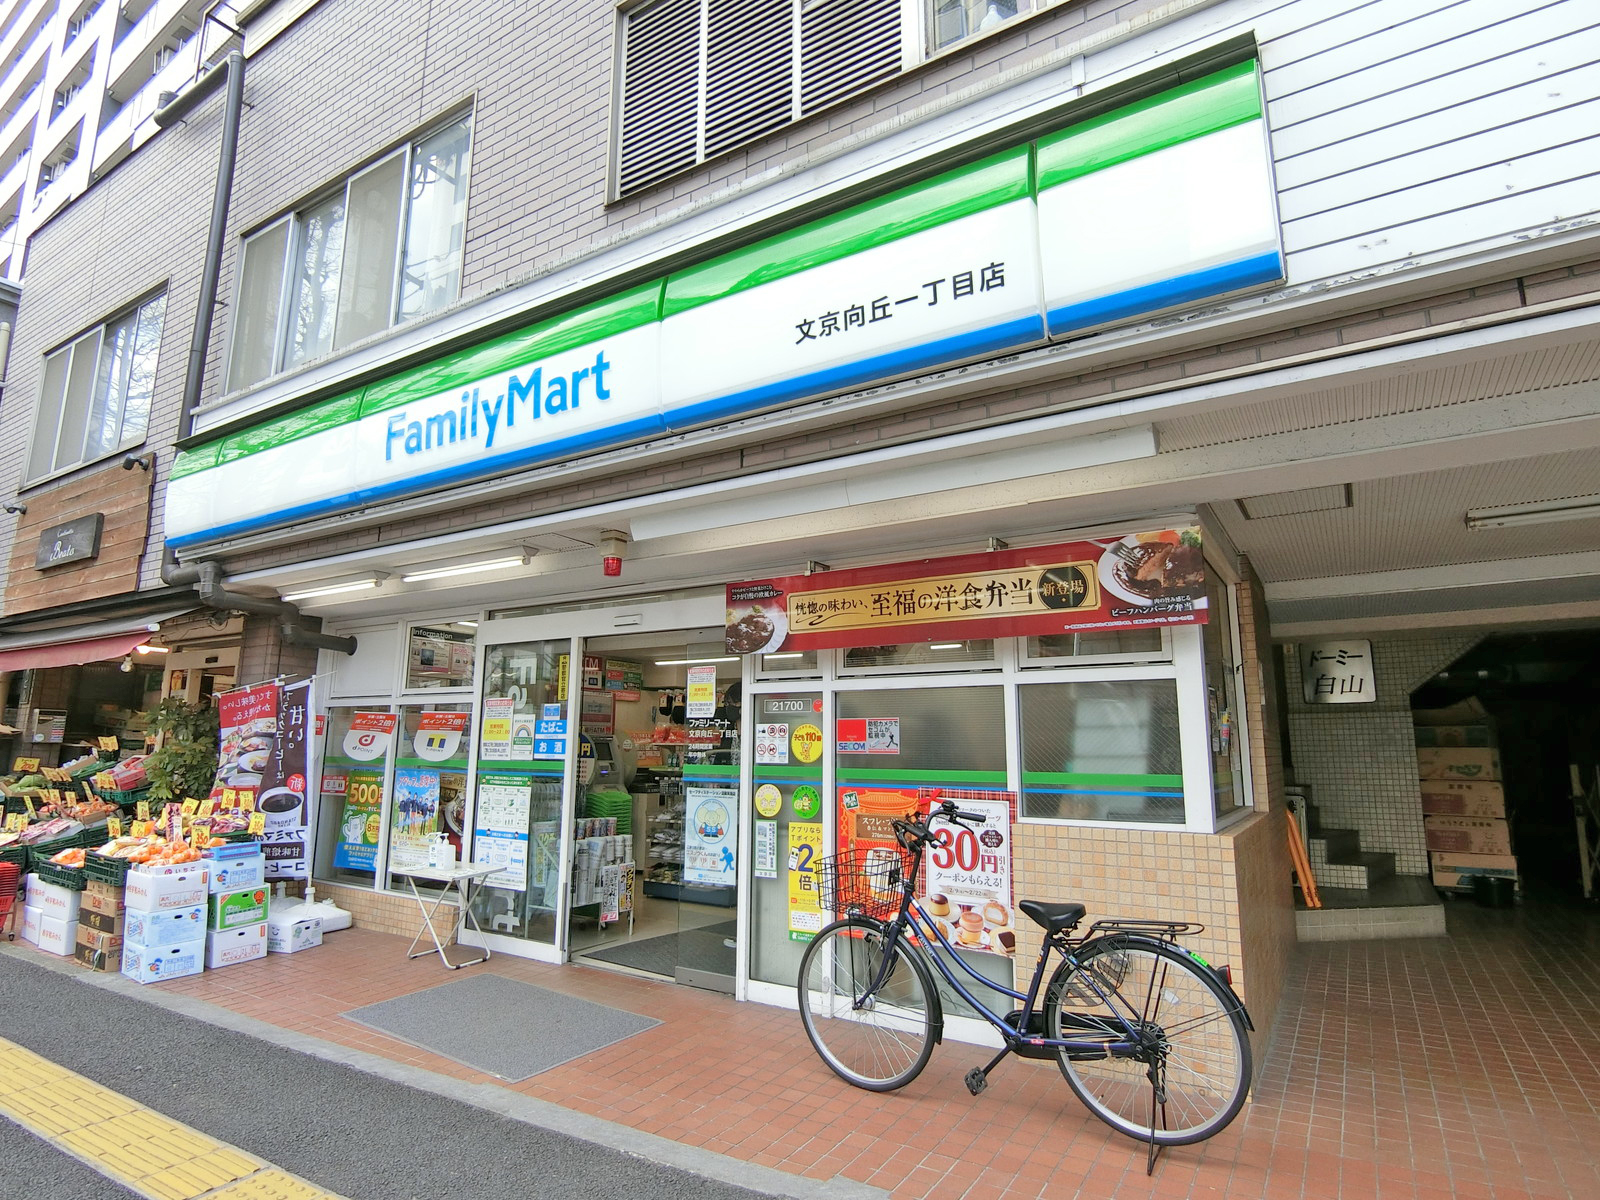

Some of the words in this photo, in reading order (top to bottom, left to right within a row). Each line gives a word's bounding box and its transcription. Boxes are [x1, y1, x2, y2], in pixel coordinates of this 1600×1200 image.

[795, 262, 1005, 345] 文京向丘一丁目店
[385, 350, 610, 461] FamilyMart
[1042, 579, 1084, 597] 新登場
[795, 597, 868, 616] 恍惚の味わい、
[870, 577, 1033, 617] 至福の洋食弁当
[1111, 603, 1193, 617] ビーフハンバーグ弁当
[413, 628, 453, 640] Information
[1310, 649, 1364, 667] ドーミー
[1315, 674, 1364, 695] 白山
[772, 701, 804, 711] 21700
[540, 722, 563, 733] たばこ
[689, 719, 731, 728] ファミリーマート
[689, 729, 738, 738] 文京向丘一丁目店
[839, 742, 866, 751] SECOM
[790, 826, 821, 834] アプリなら
[195, 833, 208, 845] 350
[790, 834, 821, 842] Tポイント
[797, 843, 814, 872] 2
[932, 828, 980, 872] 30
[981, 854, 999, 874] 円
[175, 866, 196, 874] いちご
[799, 874, 812, 891] 倍
[935, 871, 1003, 888] クーポンもらえる!
